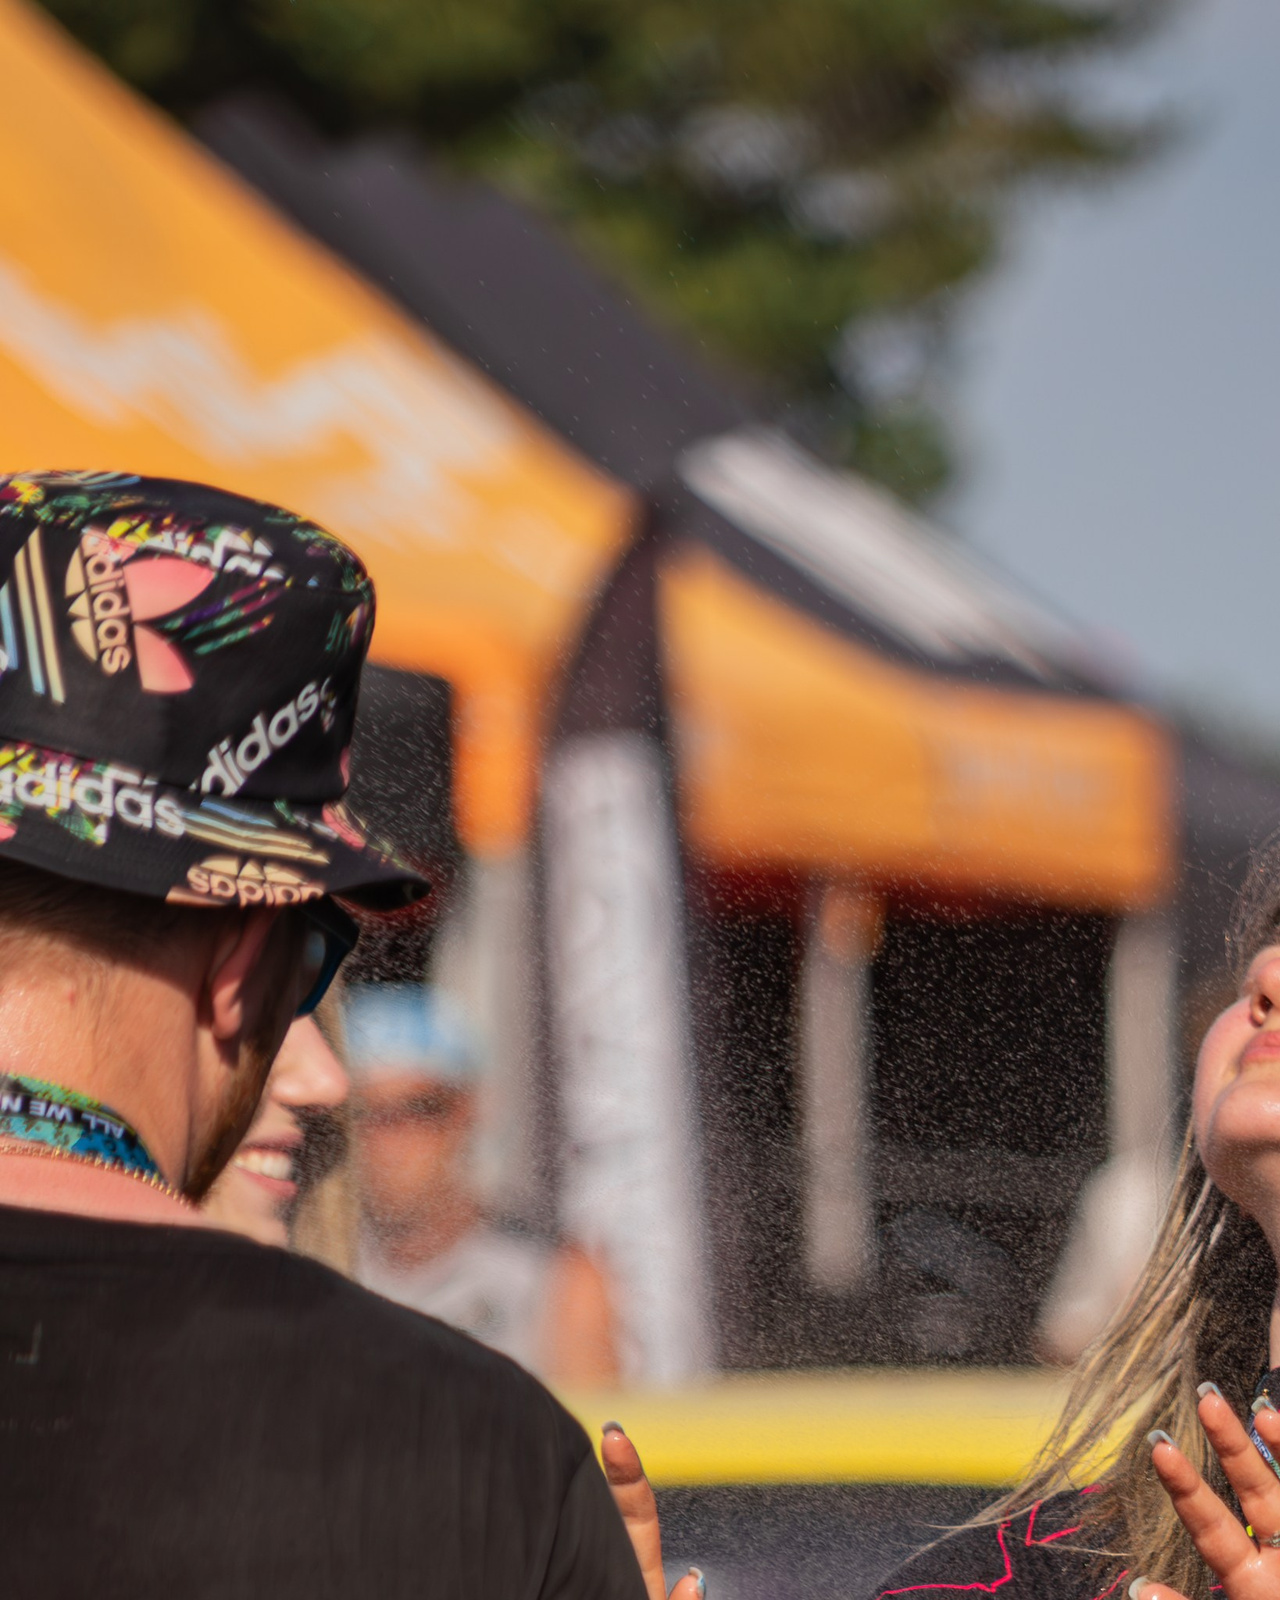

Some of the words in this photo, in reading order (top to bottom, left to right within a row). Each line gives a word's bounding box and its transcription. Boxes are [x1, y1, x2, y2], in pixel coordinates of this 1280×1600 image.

[84, 552, 132, 675] didas
[198, 680, 322, 797] didas
[28, 1099, 74, 1123] WE
[80, 1111, 125, 1140] ALL
